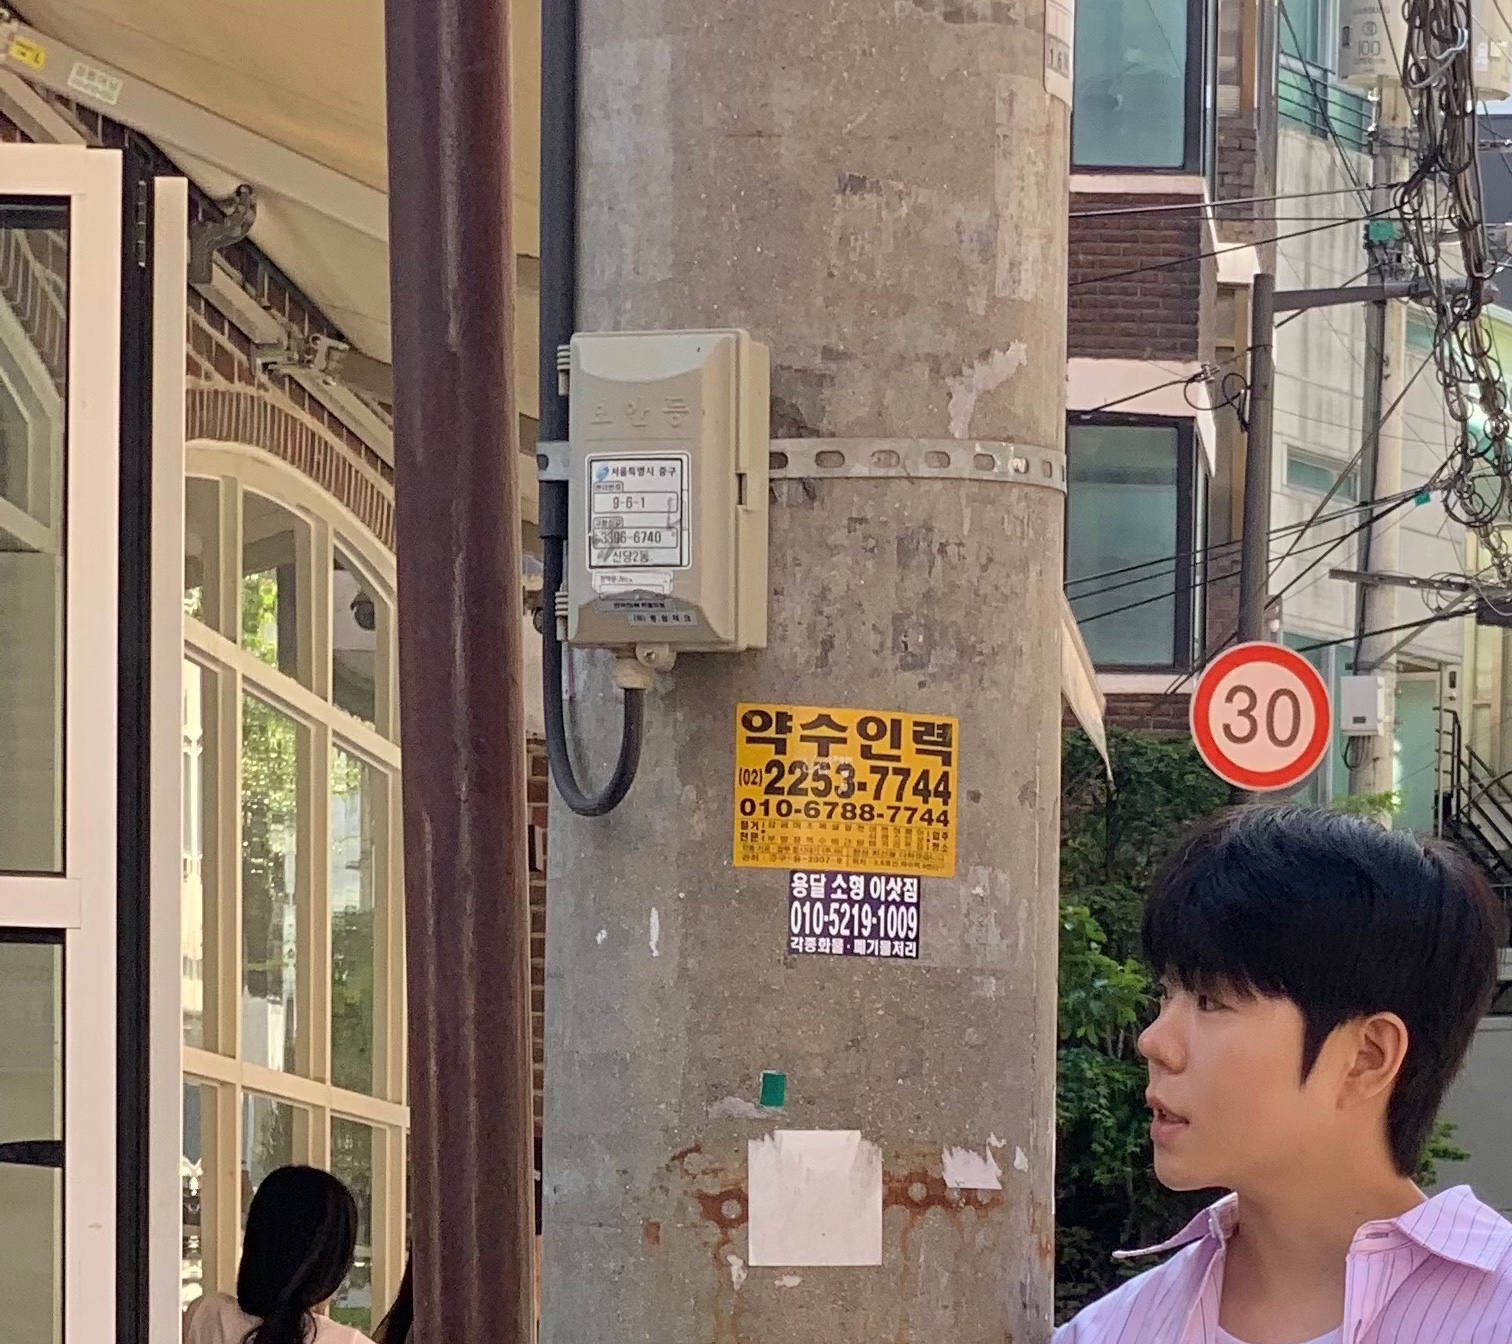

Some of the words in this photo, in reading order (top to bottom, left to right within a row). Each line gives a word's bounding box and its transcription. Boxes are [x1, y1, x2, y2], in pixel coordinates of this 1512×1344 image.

[611, 466, 655, 477] 서울특별시
[659, 466, 677, 477] 중구
[612, 496, 646, 509] 9-6-1
[1221, 684, 1302, 748] 30
[741, 709, 953, 767] 약수인력
[739, 798, 950, 827] 010-6788-7744
[790, 872, 827, 899] 용달
[830, 873, 865, 901] 소형
[869, 875, 918, 904] 이삿짐
